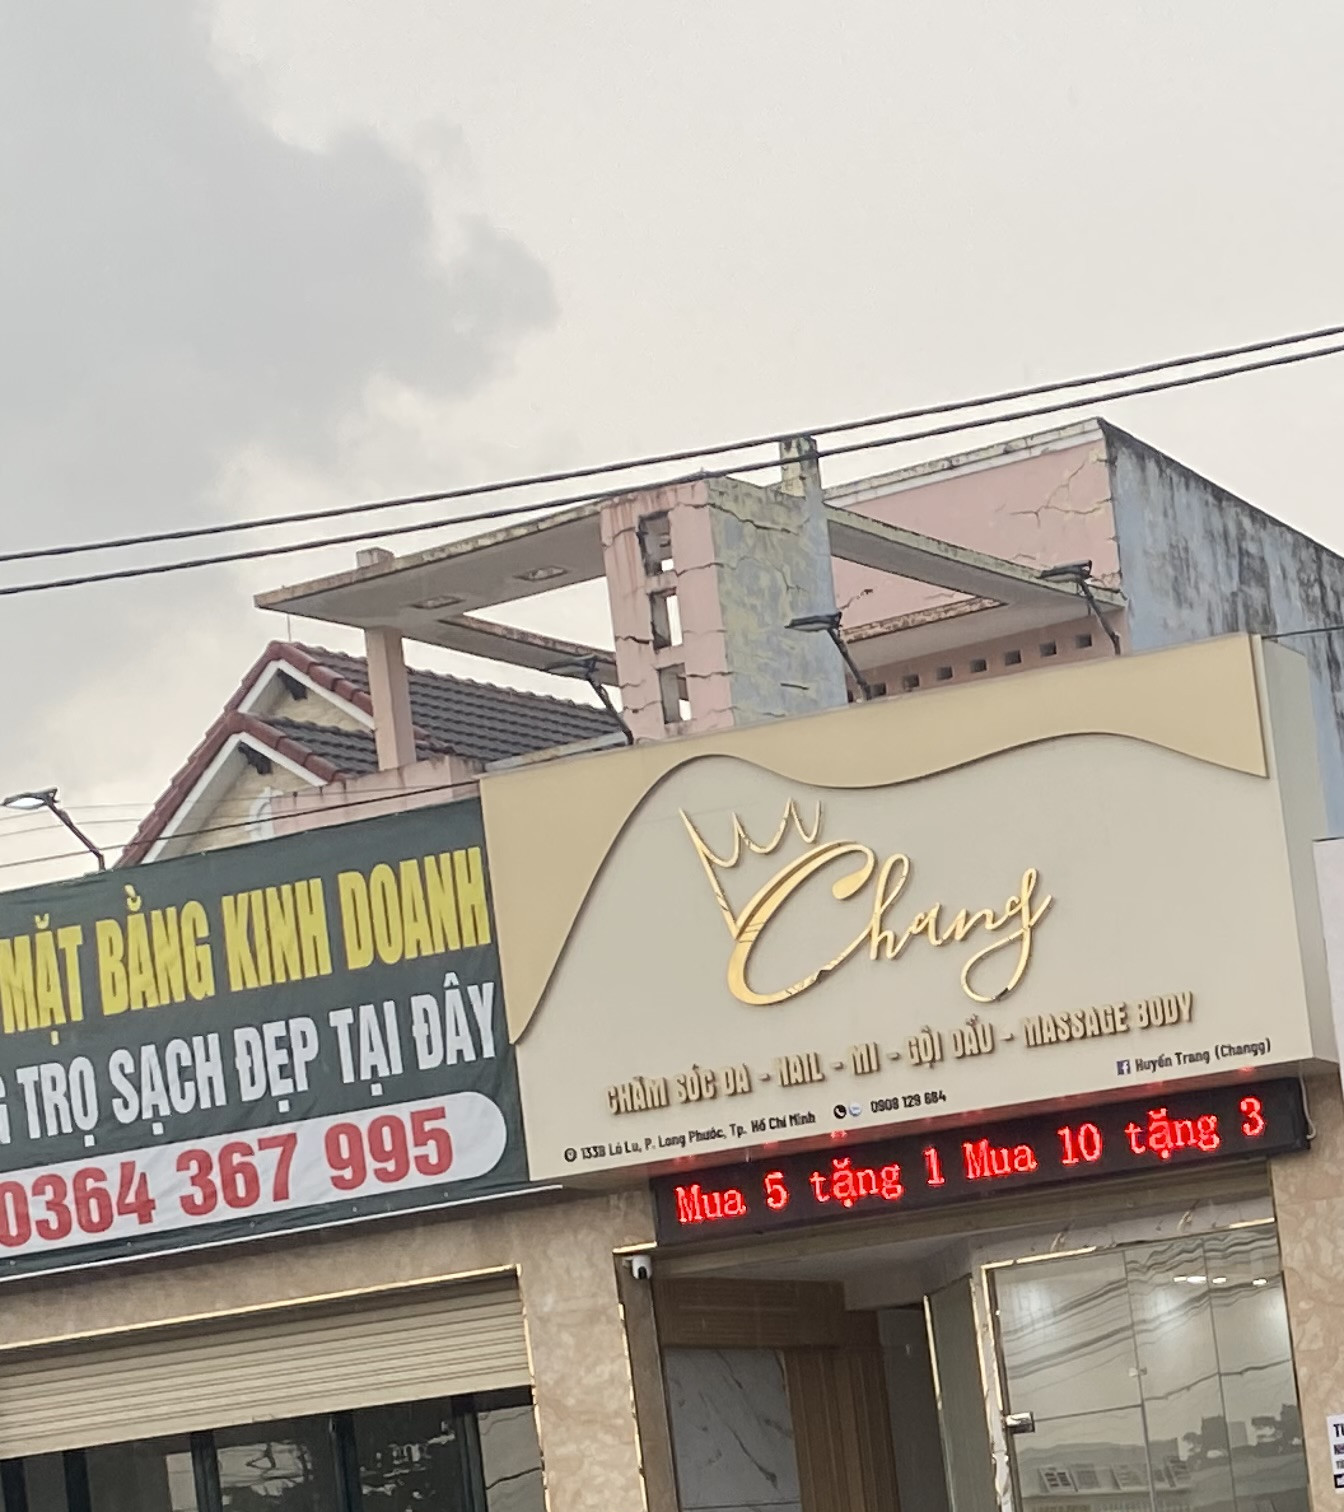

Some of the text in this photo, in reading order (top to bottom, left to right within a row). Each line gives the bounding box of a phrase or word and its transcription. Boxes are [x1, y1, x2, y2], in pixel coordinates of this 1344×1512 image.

[0, 846, 491, 1046] MẶT BẰNG KINH DOANH
[727, 837, 1054, 1006] Chang
[17, 1056, 99, 1147] TRỌ
[110, 1033, 227, 1135] SẠCH
[233, 1016, 320, 1113] ĐẸP
[329, 1000, 404, 1096] TẠI
[411, 972, 497, 1069] ĐÂY
[606, 1073, 670, 1117] CHĂM
[676, 1063, 718, 1103] SÓC
[723, 1062, 752, 1098] DA
[774, 1052, 826, 1089] NAIL
[850, 1041, 881, 1078] MI
[906, 1025, 944, 1069] GỘI
[1022, 1000, 1130, 1049] MASSAGE
[1136, 990, 1195, 1034] BODY
[1176, 1046, 1211, 1070] Trang
[0, 1107, 454, 1247] 0364 367 995
[658, 1130, 687, 1151] Long
[789, 1109, 817, 1128] Minh
[675, 1096, 1267, 1224] Mua 5 tặng 1 Mua 10 tặng 3
